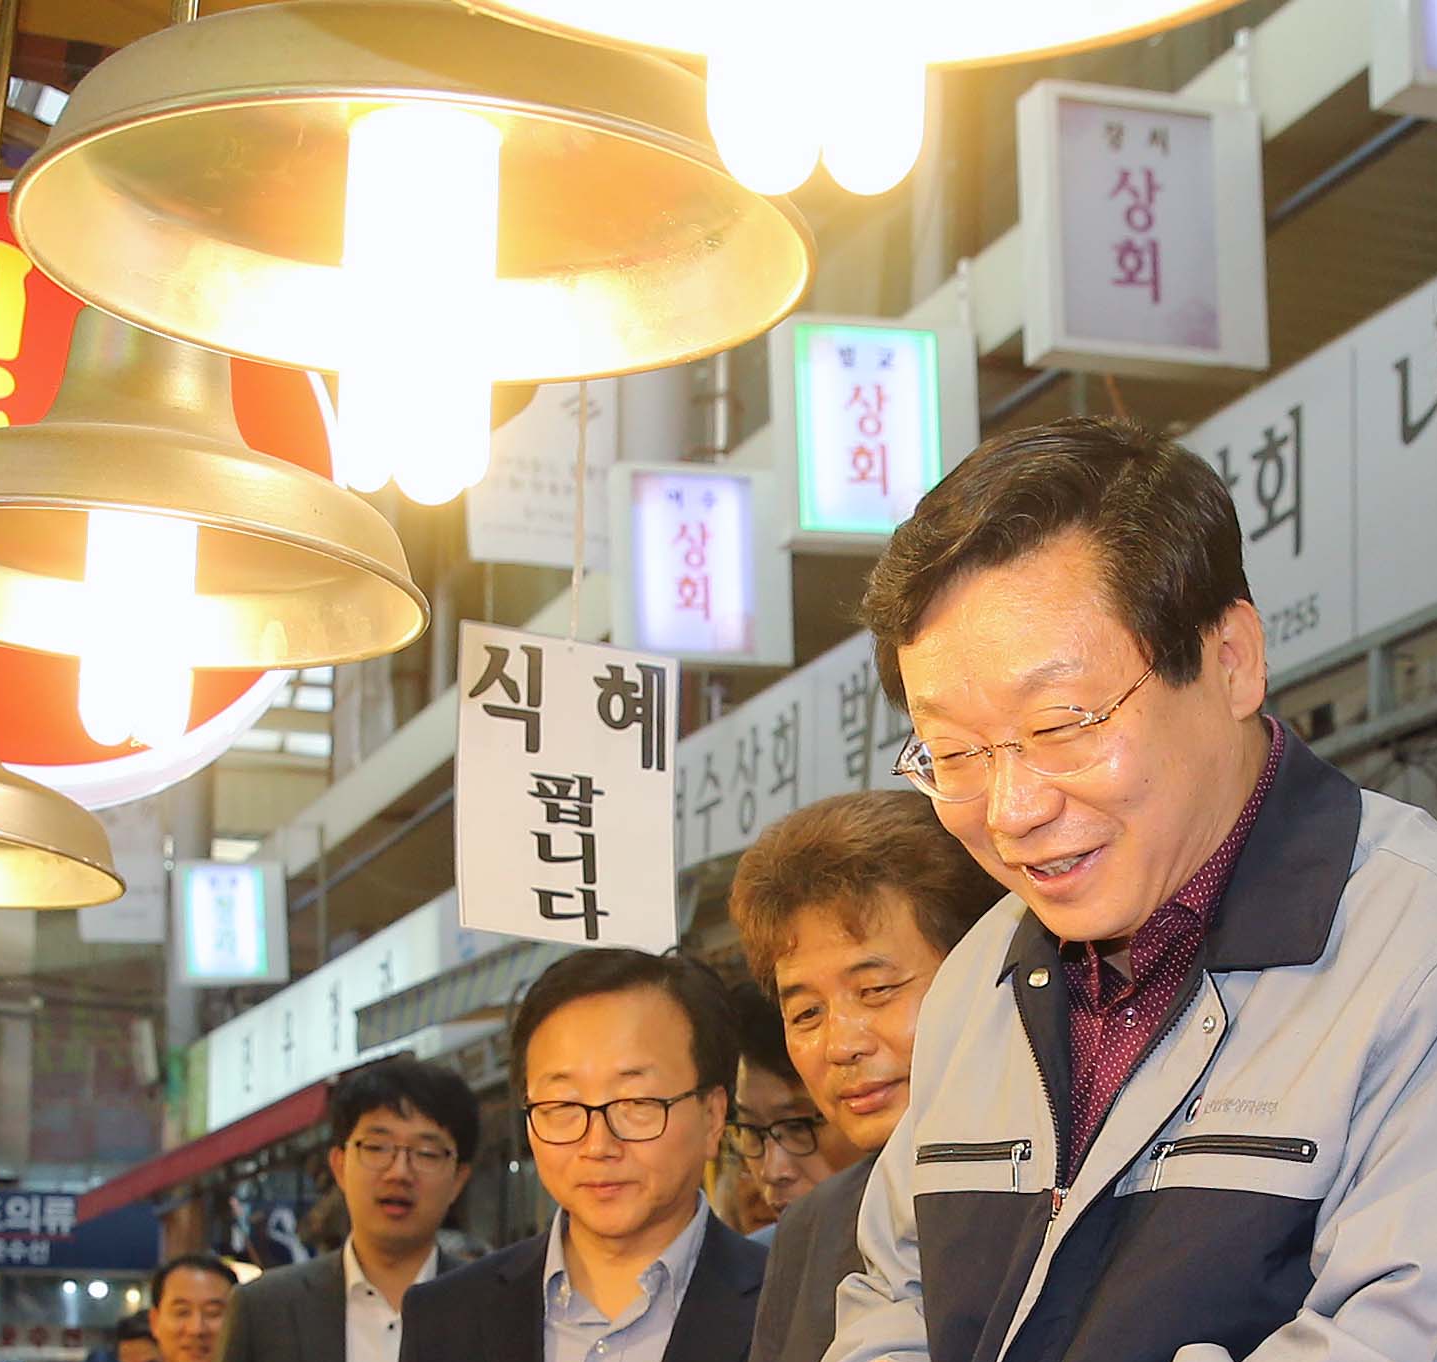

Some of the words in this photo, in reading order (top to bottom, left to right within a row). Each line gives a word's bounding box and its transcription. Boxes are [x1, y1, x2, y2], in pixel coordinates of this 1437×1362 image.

[1110, 167, 1162, 304] 상회
[844, 383, 889, 497] 상회
[673, 520, 712, 622] 상회
[468, 644, 667, 772] 식혜
[674, 701, 800, 863] 수상회
[527, 773, 610, 941] 팝니다
